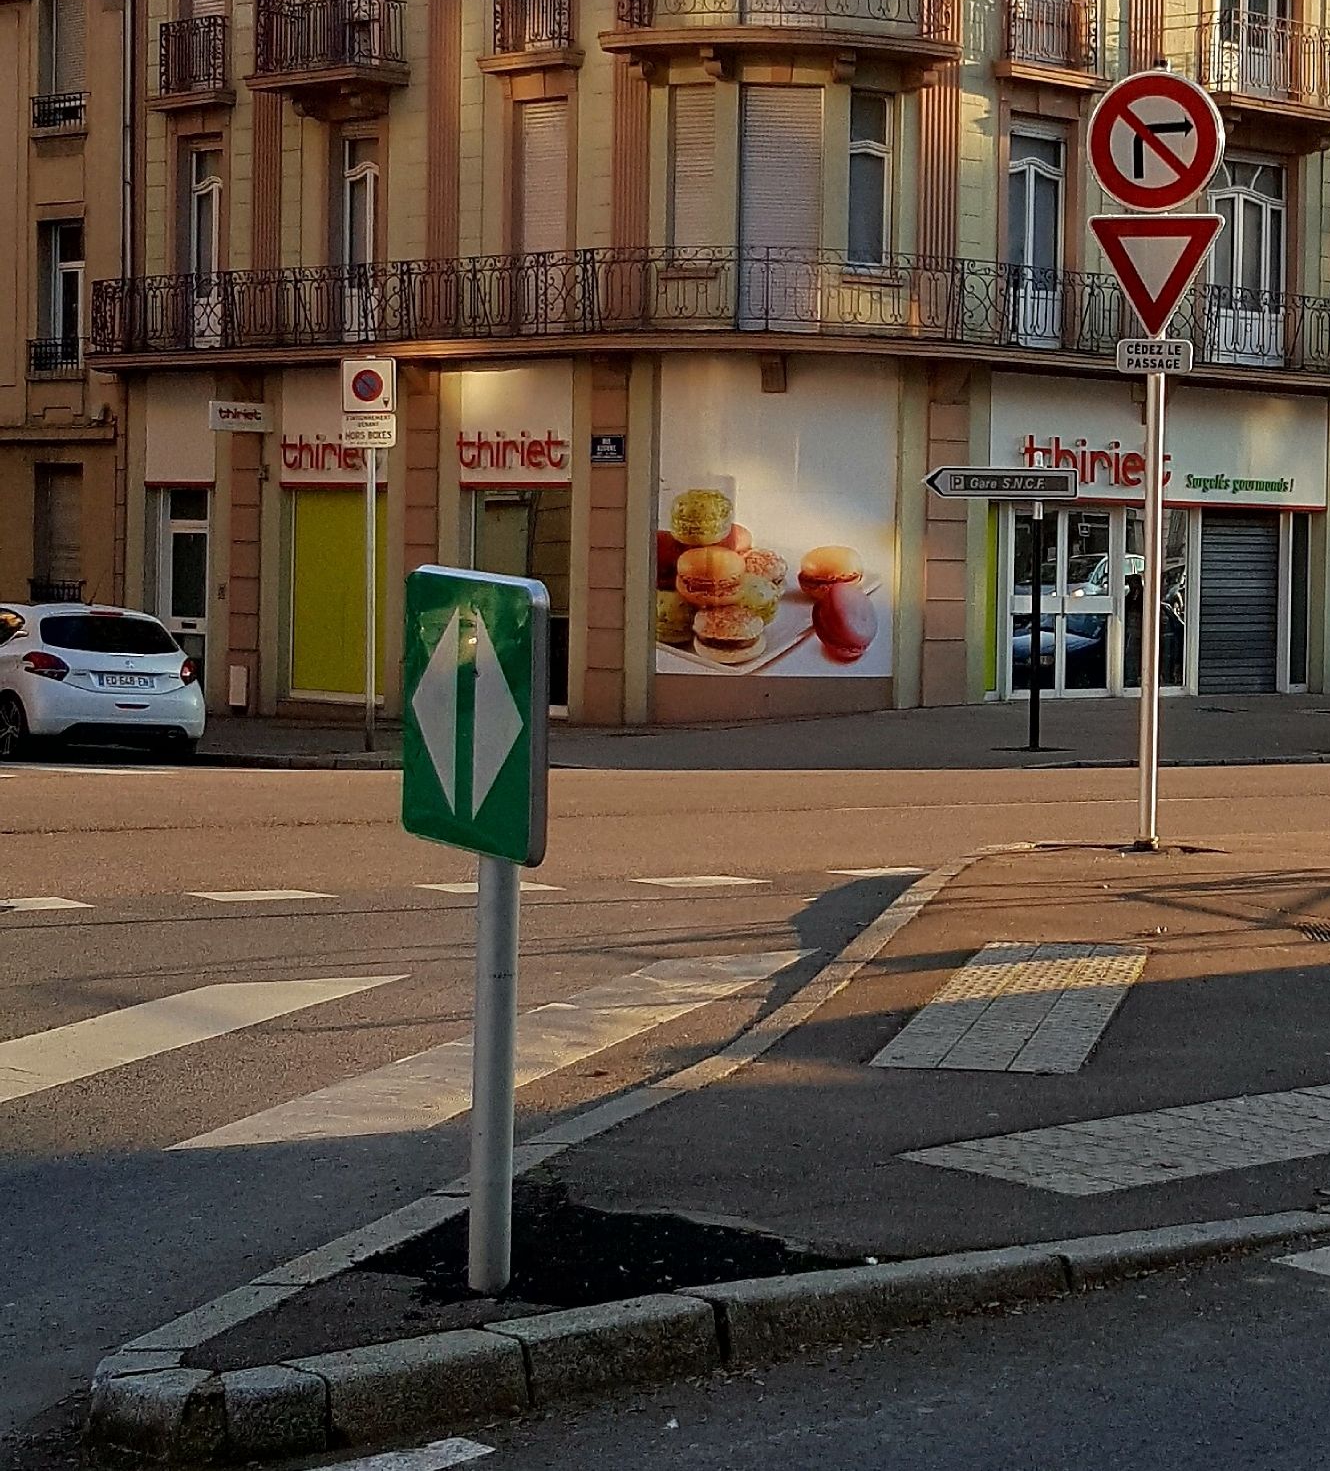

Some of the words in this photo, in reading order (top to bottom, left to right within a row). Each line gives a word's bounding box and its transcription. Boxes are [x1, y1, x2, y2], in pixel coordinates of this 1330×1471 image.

[1127, 342, 1163, 355] CÉDEZ
[1168, 344, 1182, 356] LE
[1127, 358, 1180, 370] PASSAGE
[218, 407, 262, 421] thiriet
[345, 431, 366, 440] HORS
[456, 430, 567, 469] thiriet
[970, 477, 998, 489] Gare
